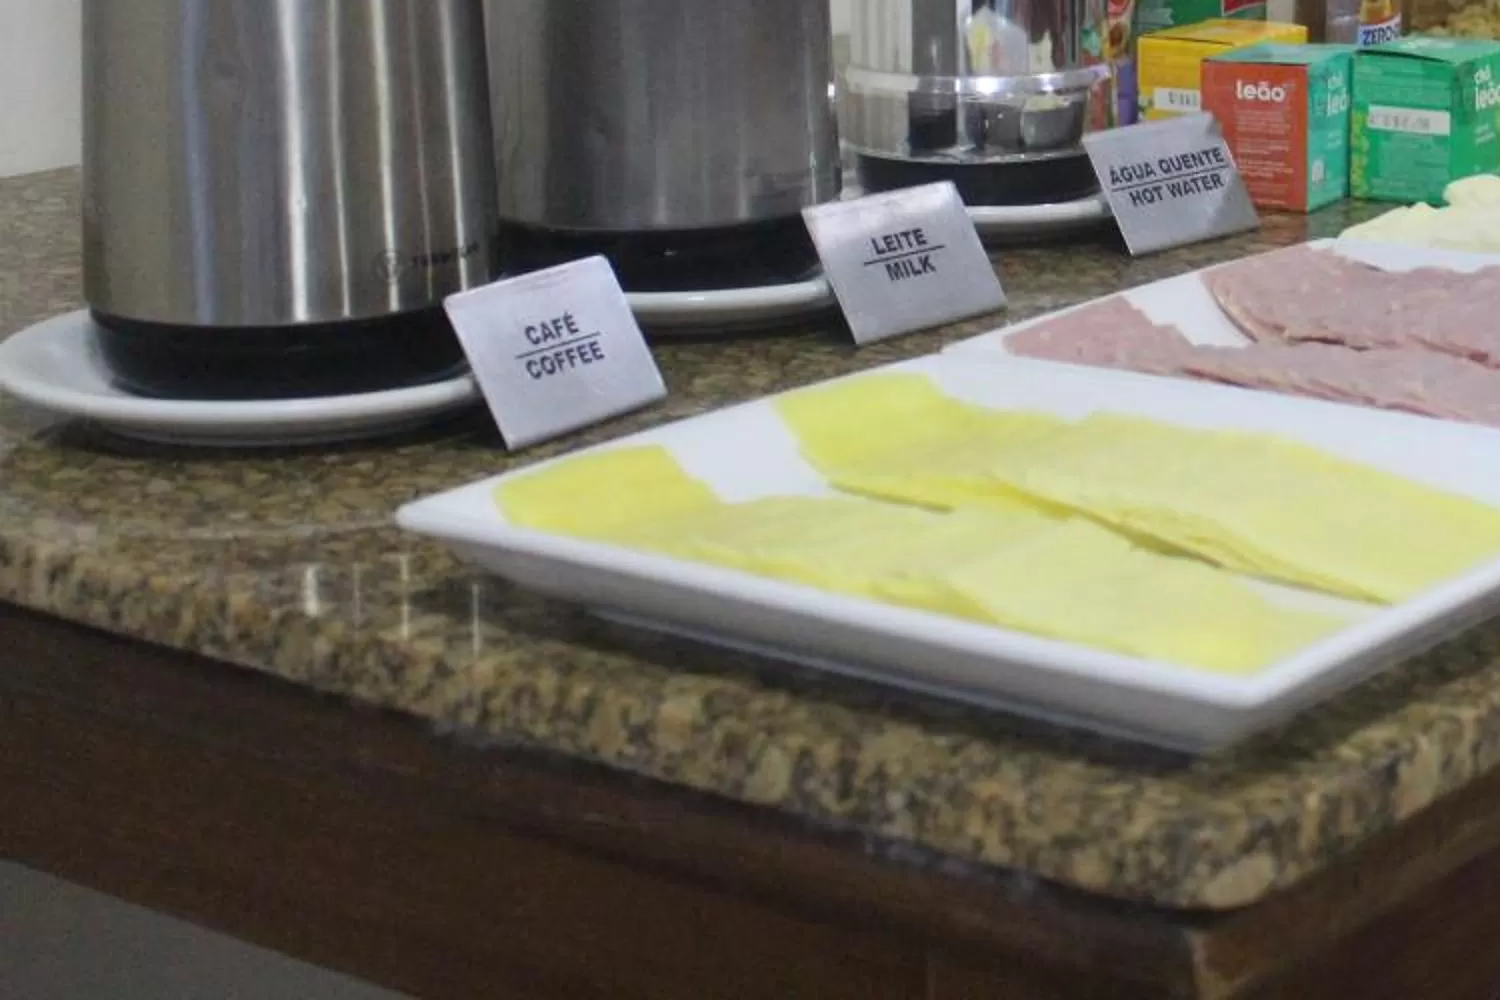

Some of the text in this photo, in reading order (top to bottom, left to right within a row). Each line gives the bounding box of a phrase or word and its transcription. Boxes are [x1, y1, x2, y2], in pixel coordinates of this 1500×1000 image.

[1235, 79, 1286, 102] leão
[1158, 146, 1225, 174] QUENTE
[1129, 173, 1225, 207] HOT WATER
[870, 227, 928, 255] LEITE
[884, 254, 937, 282] MILK
[524, 309, 580, 345] CAFÉ
[525, 340, 605, 380] COFFEE
